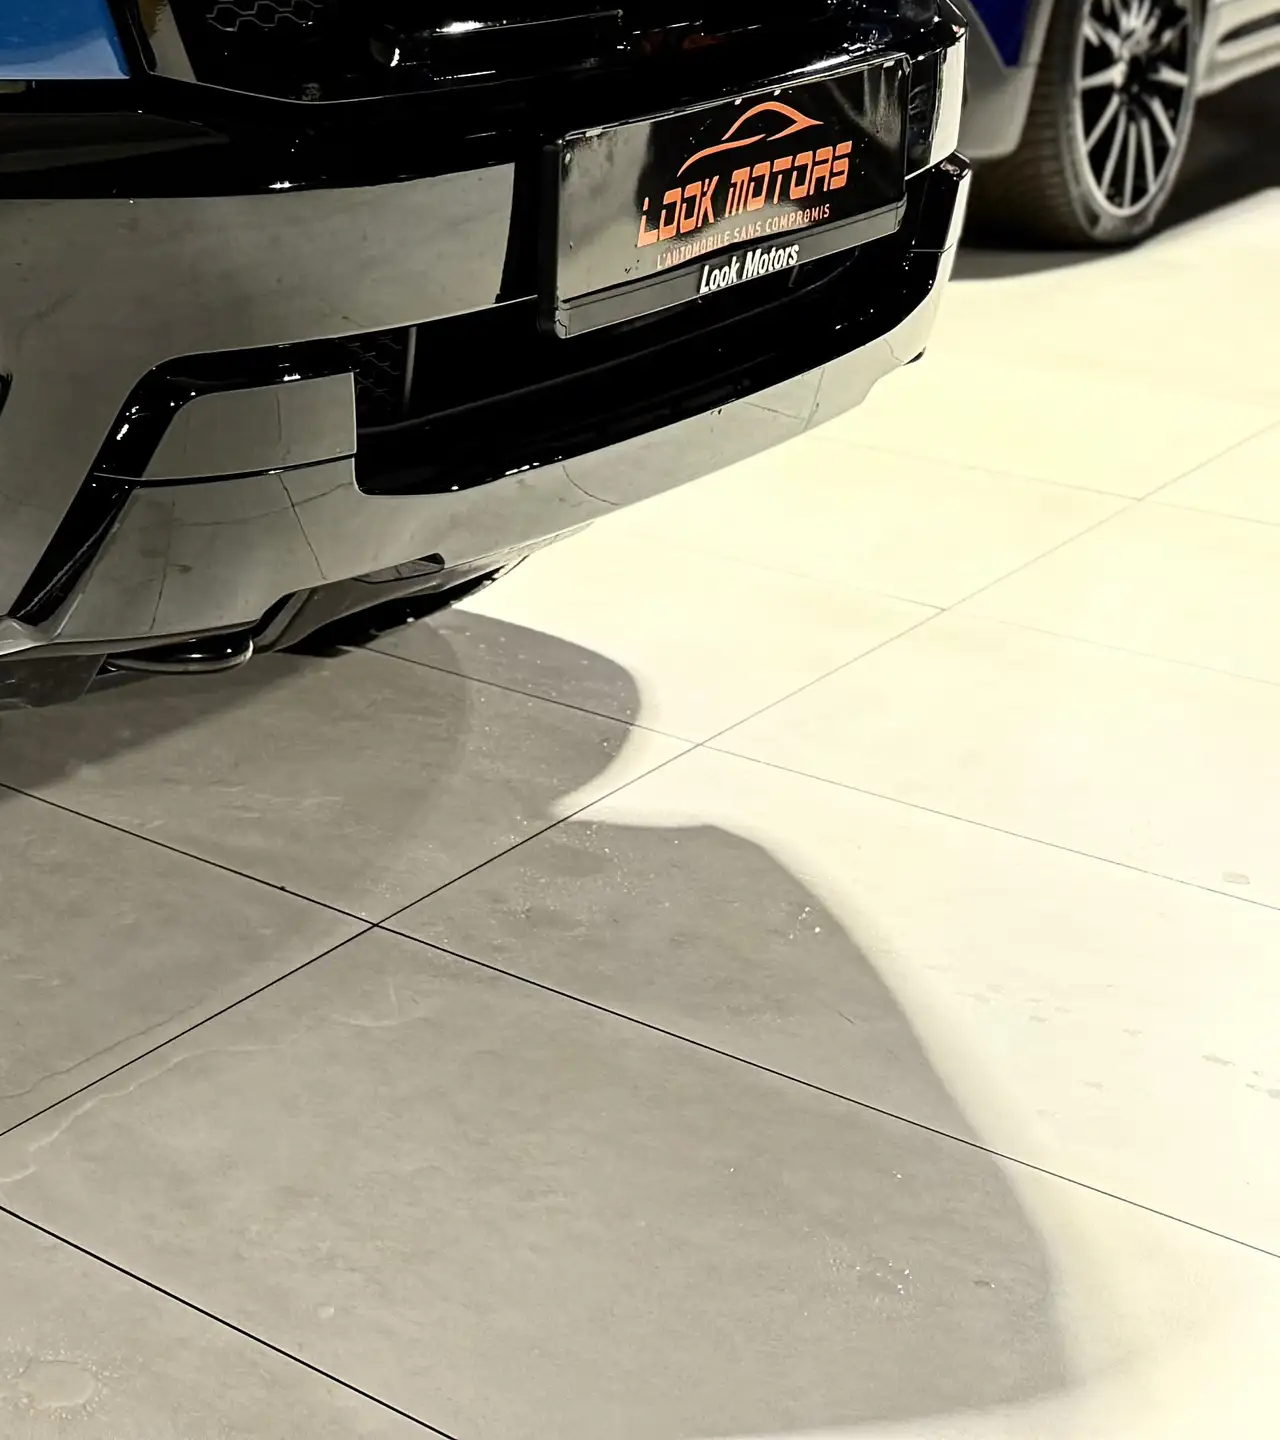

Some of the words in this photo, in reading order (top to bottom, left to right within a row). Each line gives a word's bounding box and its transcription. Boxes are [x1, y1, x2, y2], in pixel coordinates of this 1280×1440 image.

[637, 175, 719, 248] LOOK
[724, 140, 853, 218] MOTORS
[656, 232, 730, 269] L'AUTOMOBILE
[733, 221, 762, 240] SANS
[765, 203, 830, 234] COMPROMIS
[699, 260, 740, 294] Look
[742, 244, 800, 280] Motors
